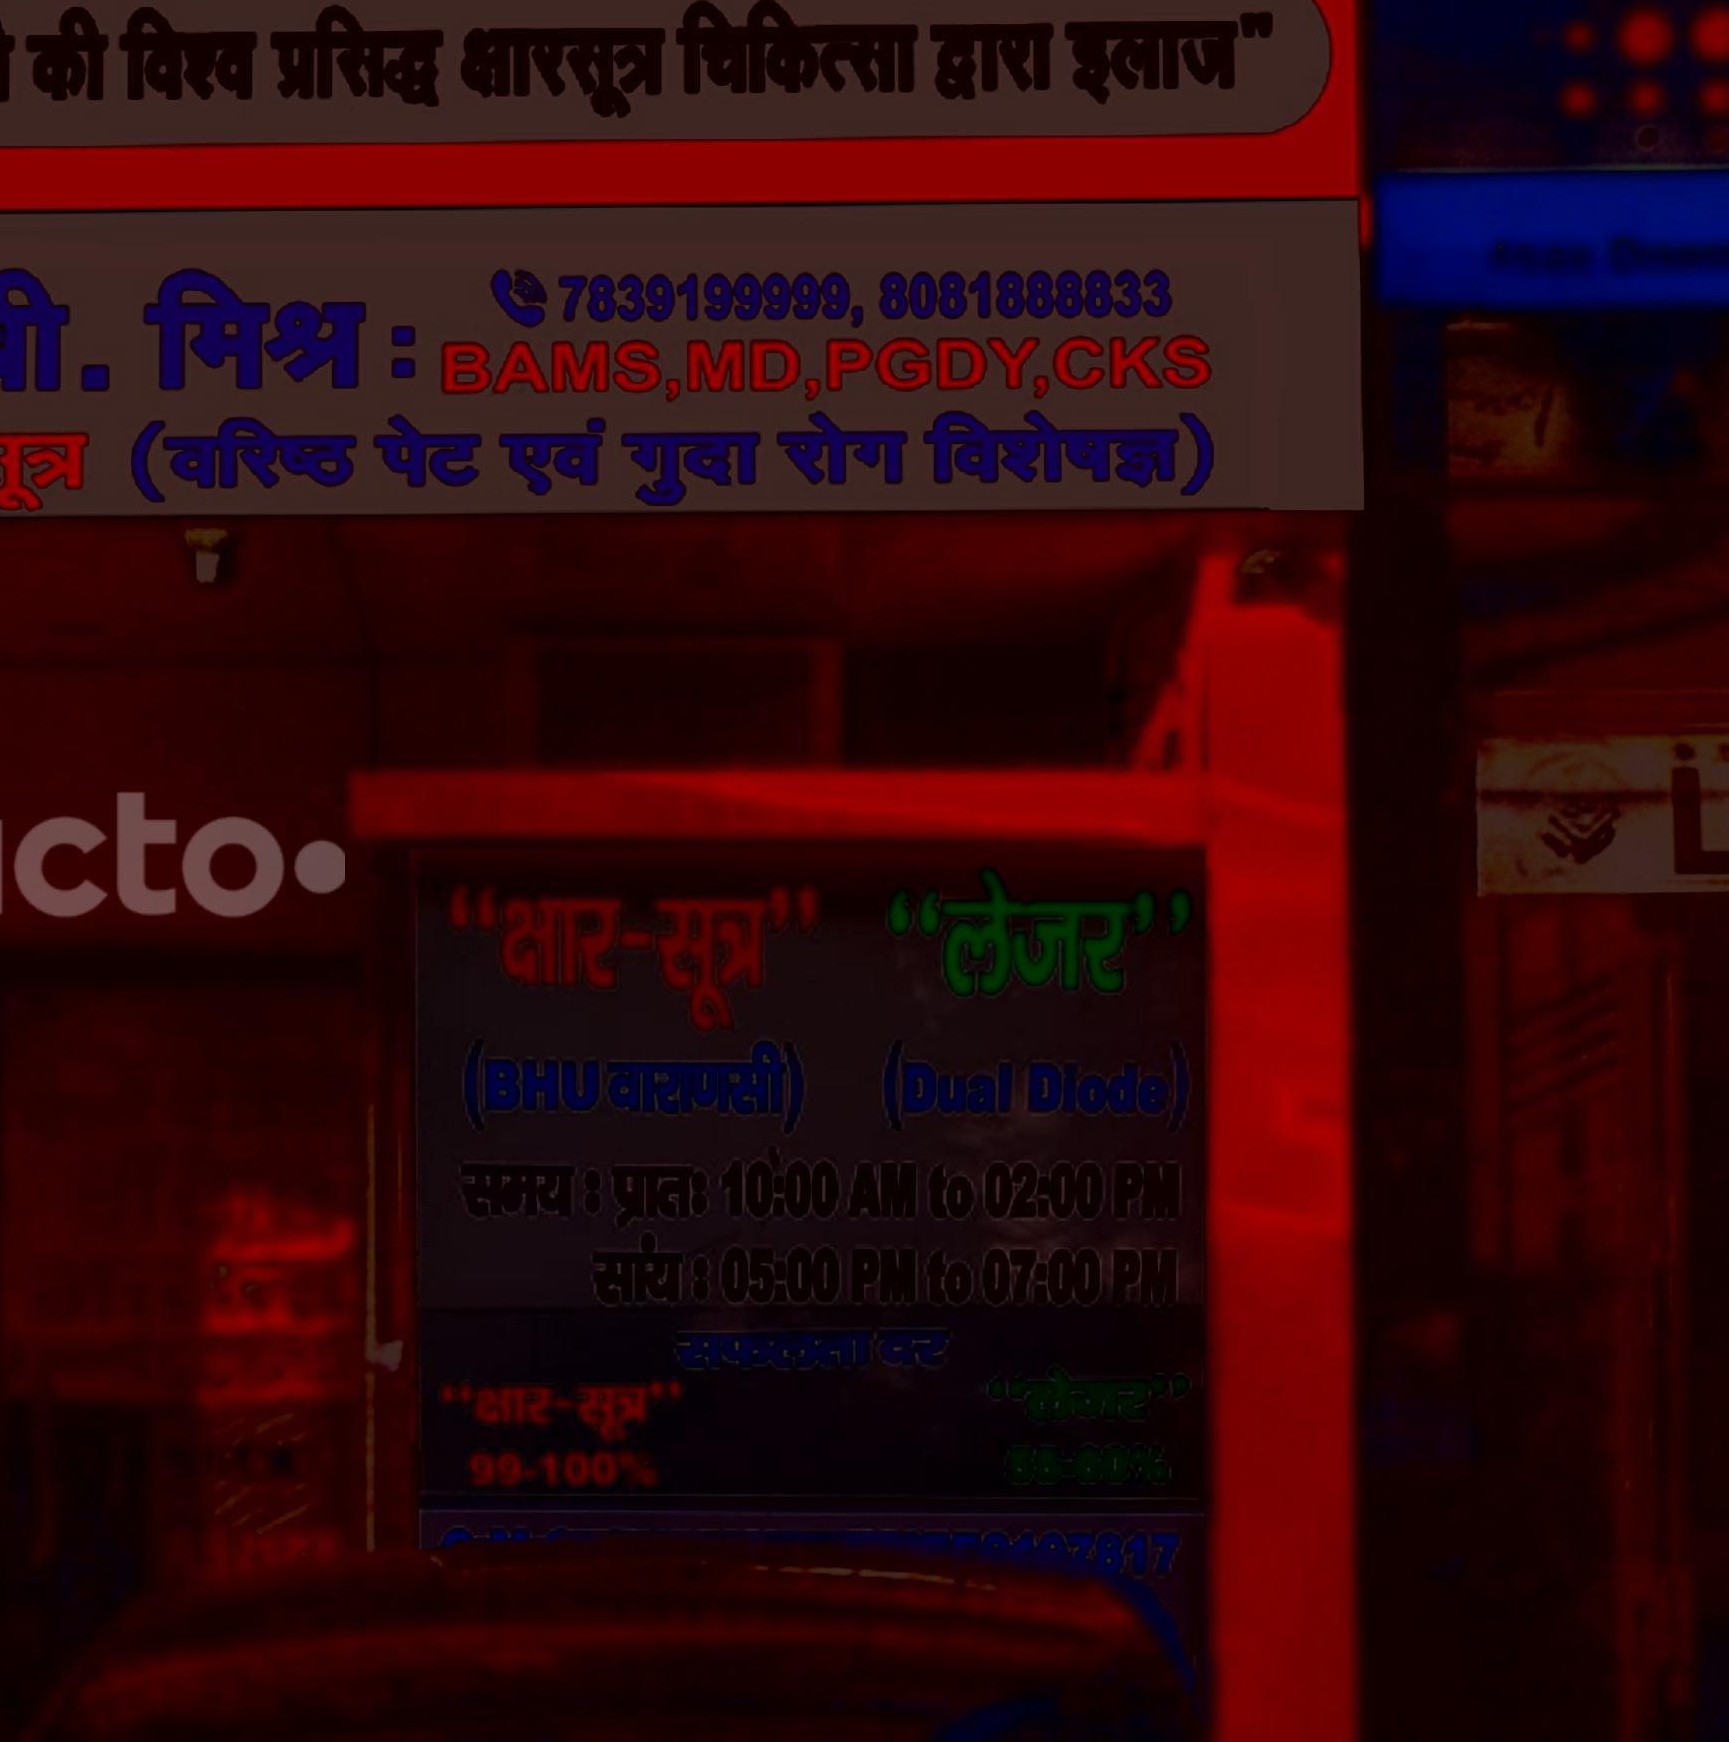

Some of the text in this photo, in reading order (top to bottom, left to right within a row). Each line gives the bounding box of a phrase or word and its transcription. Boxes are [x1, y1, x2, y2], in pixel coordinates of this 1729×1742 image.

[27, 7, 108, 101] की
[121, 6, 257, 101] विश्व
[272, 5, 443, 106] प्रसिद्ध
[459, 26, 665, 117] क्षारसूत्र
[676, 0, 918, 95] चिकित्सा
[930, 22, 1052, 98] द्वारा
[559, 269, 1171, 327] 7839199999, 8081888833
[131, 417, 357, 503] (वरिष्ठ
[375, 414, 481, 490] पेट
[500, 418, 604, 495] एवं
[622, 432, 760, 506] गुदा
[777, 411, 906, 486] रोग
[924, 410, 1214, 495] विशेषज्ञ)
[465, 1039, 804, 1133] (BHU वाराणसी)
[884, 1039, 1190, 1132] (Dual Diode)
[461, 1162, 576, 1216] समय
[722, 1161, 839, 1218] 10:00
[849, 1162, 914, 1217] AM
[928, 1164, 973, 1218] to
[984, 1162, 1102, 1218] 02:00
[1114, 1164, 1181, 1219] PM
[721, 1248, 839, 1305] 05:00
[851, 1249, 915, 1305] PM
[927, 1250, 975, 1305] to
[982, 1248, 1100, 1305] 07:00
[1114, 1248, 1178, 1305] PM
